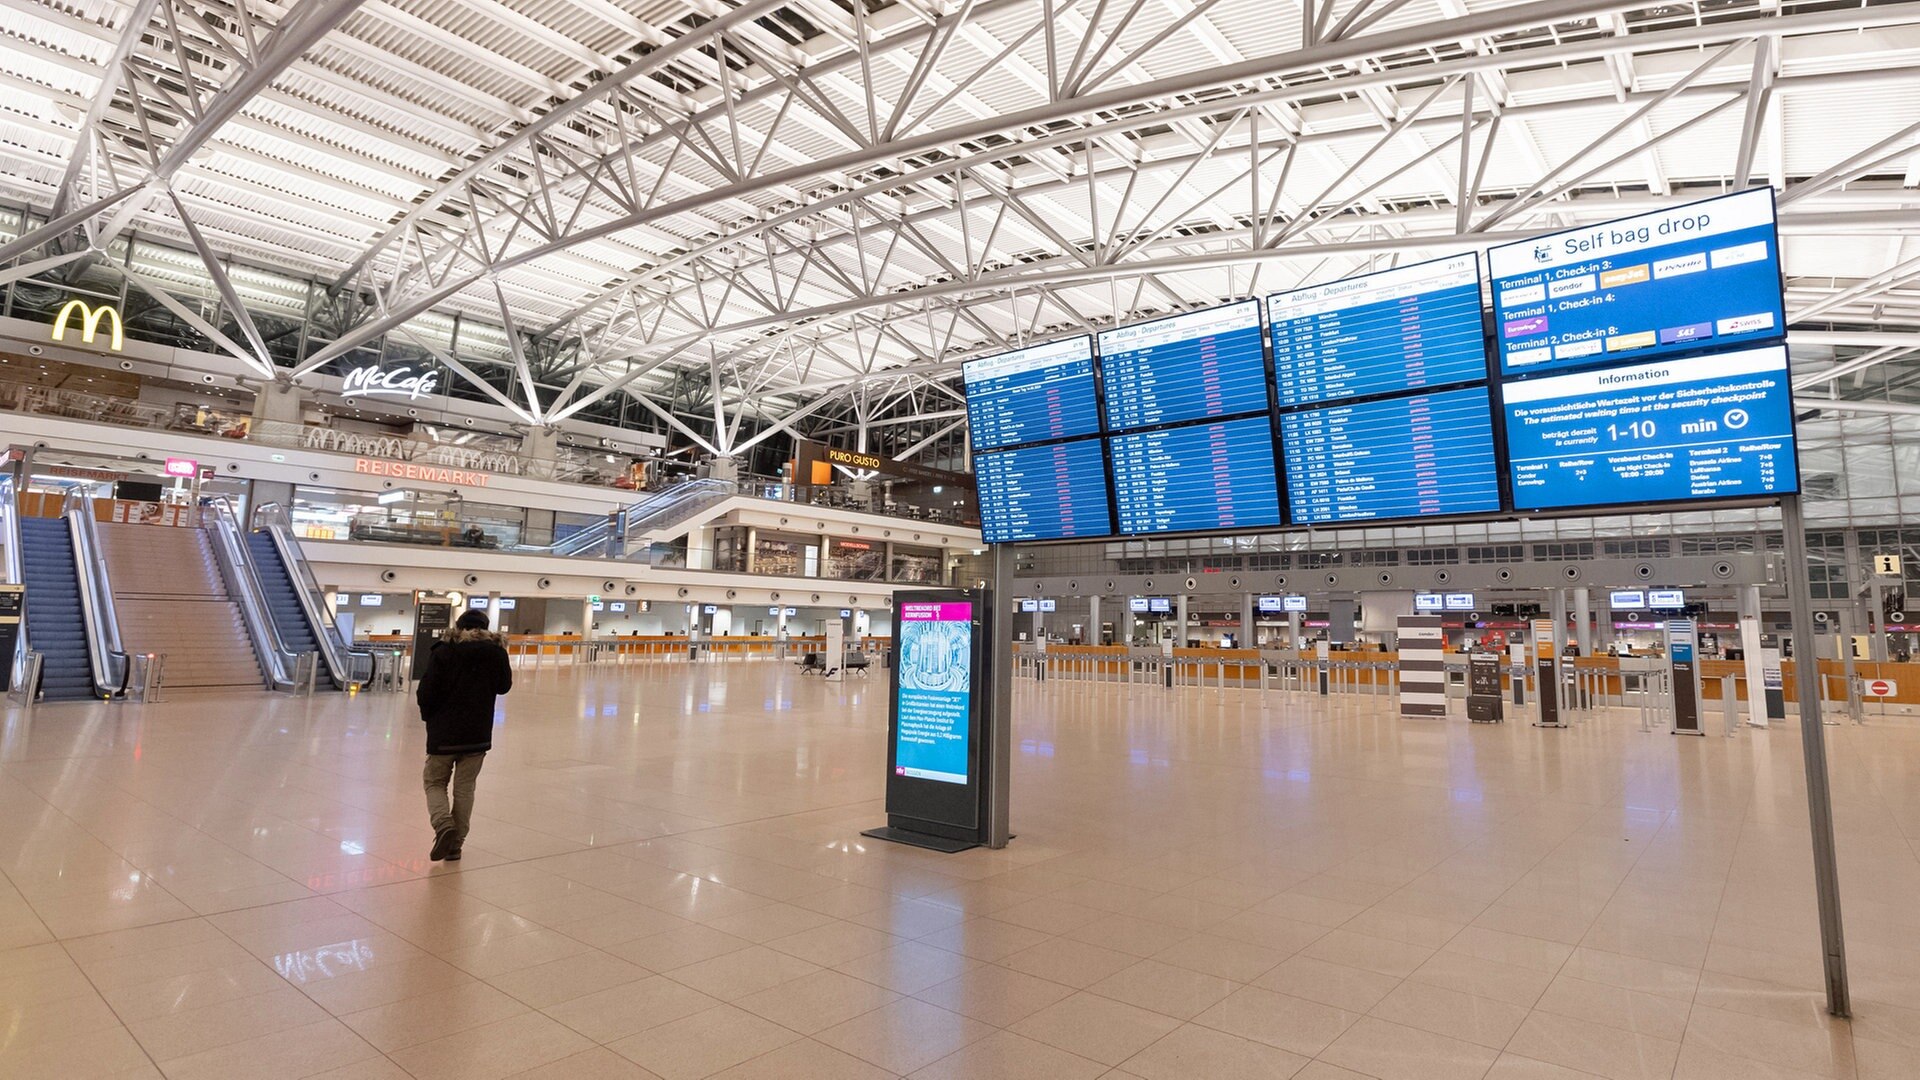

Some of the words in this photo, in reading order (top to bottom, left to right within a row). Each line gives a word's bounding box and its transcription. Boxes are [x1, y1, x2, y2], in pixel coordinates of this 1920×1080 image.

[1564, 232, 1603, 254] Self
[1610, 227, 1649, 244] bag
[1658, 214, 1710, 235] drop
[1499, 274, 1542, 289] Terminal
[1544, 272, 1553, 281] 1,
[1555, 263, 1598, 278] Check-in
[1602, 260, 1612, 269] 3:
[1290, 290, 1317, 304] Abflug
[1322, 278, 1368, 297] Departures
[1553, 282, 1582, 292] condor
[1503, 305, 1545, 319] Terminal
[1547, 304, 1556, 312] 1,
[1558, 296, 1602, 310] Check-in
[1604, 293, 1615, 301] 4:
[1675, 326, 1696, 338] SAS
[1738, 317, 1762, 328] SWISS
[1505, 336, 1548, 350] Terminal
[1550, 335, 1560, 344] 2,
[1562, 328, 1605, 342] Check-in
[1608, 326, 1618, 334] 8:
[341, 365, 438, 400] McCafé
[1598, 369, 1669, 384] Information
[1529, 401, 1596, 414] voraussichtliche
[1596, 395, 1640, 407] Wartezeit
[1676, 379, 1775, 397] Sicherheitskontrolle
[1540, 411, 1583, 422] estimated
[1584, 408, 1617, 418] waiting
[1618, 406, 1640, 414] time
[1653, 402, 1669, 410] the
[1670, 398, 1709, 408] security
[1710, 391, 1766, 403] checkpoint
[1542, 430, 1571, 439] beträgt
[1570, 427, 1596, 436] derzeit
[1607, 420, 1655, 440] 1-10
[1681, 418, 1717, 433] min
[1563, 436, 1598, 445] currently
[830, 450, 851, 462] PURO
[853, 455, 880, 468] GUSTO
[1688, 447, 1720, 456] Terminal
[355, 458, 489, 486] REISEMARKT
